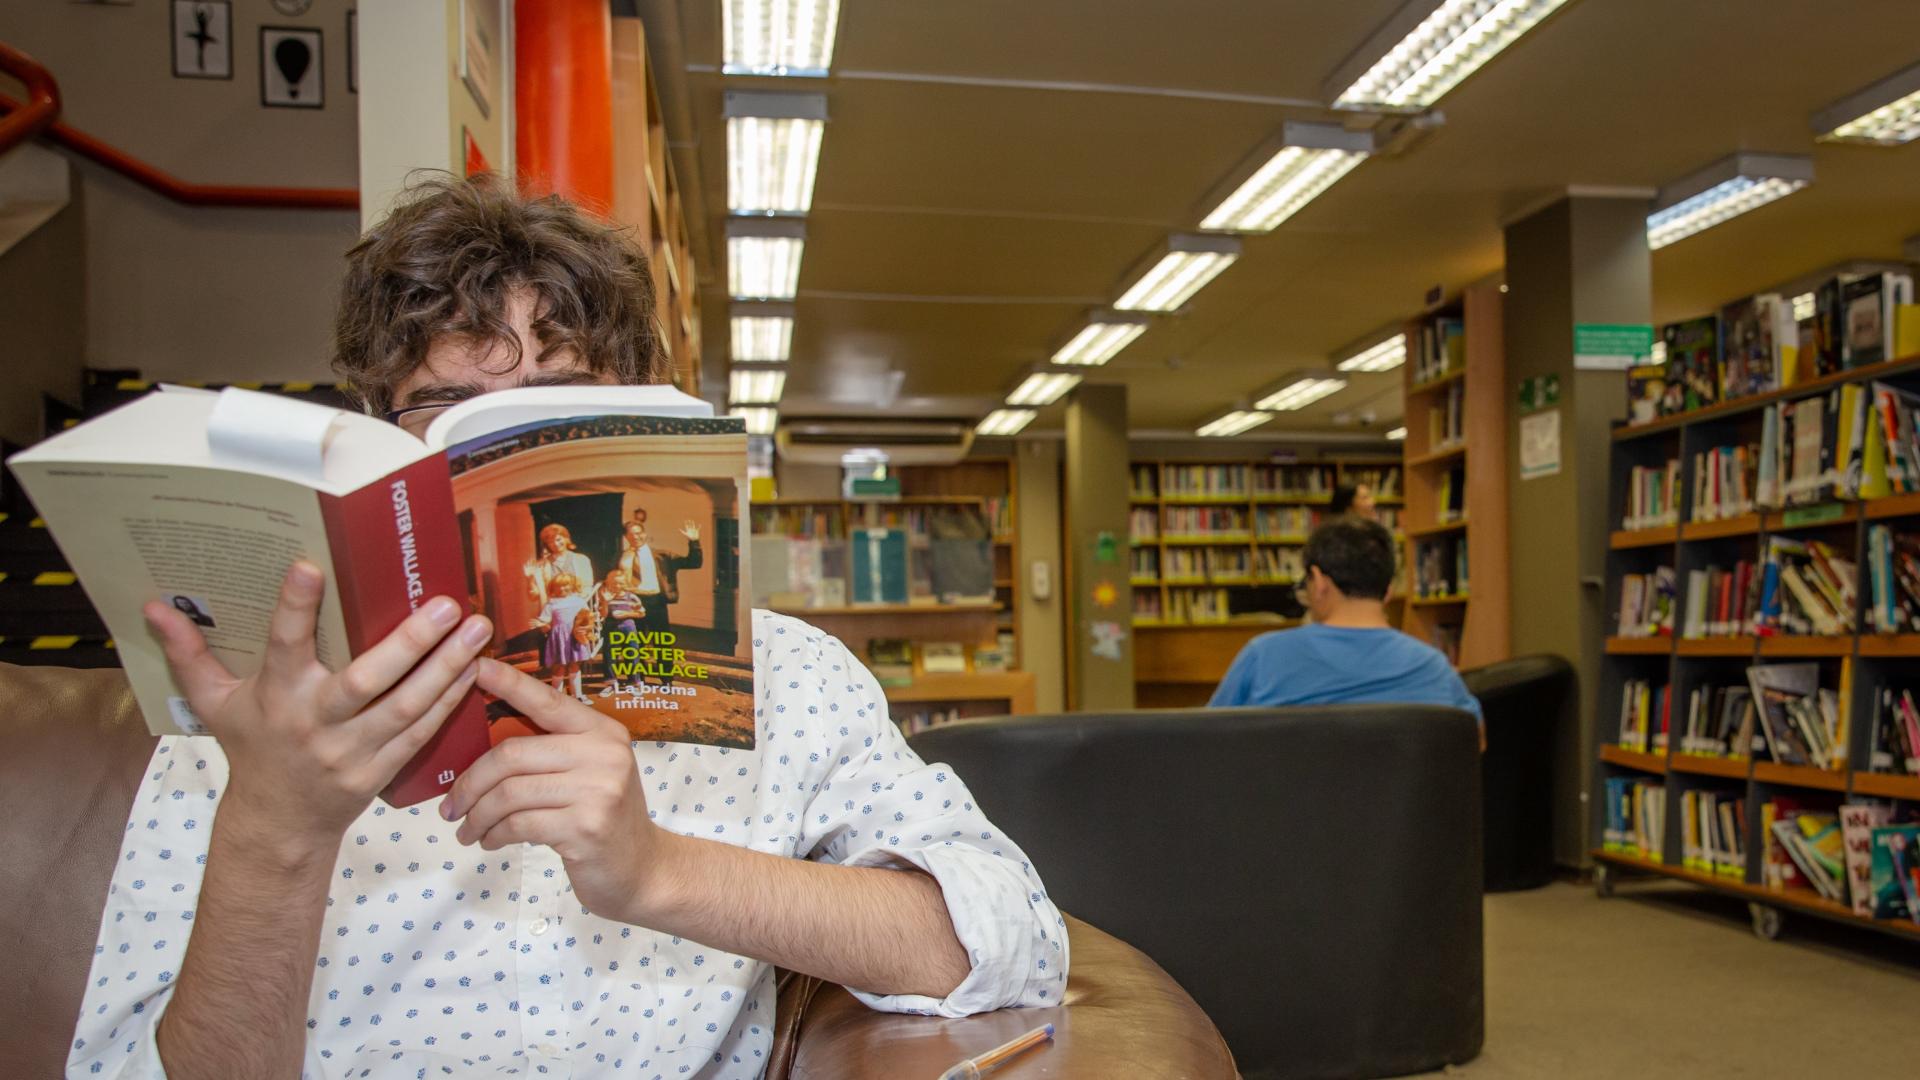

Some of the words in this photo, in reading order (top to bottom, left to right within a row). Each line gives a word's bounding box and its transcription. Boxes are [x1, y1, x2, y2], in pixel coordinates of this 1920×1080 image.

[391, 479, 413, 535] FOSTER
[400, 532, 424, 600] WALLACE
[609, 631, 677, 645] DAVID
[610, 647, 687, 662] FOSTER
[611, 662, 709, 679] WALLACE
[614, 681, 635, 694] La
[640, 681, 697, 697] broma
[615, 696, 679, 710] infinita
